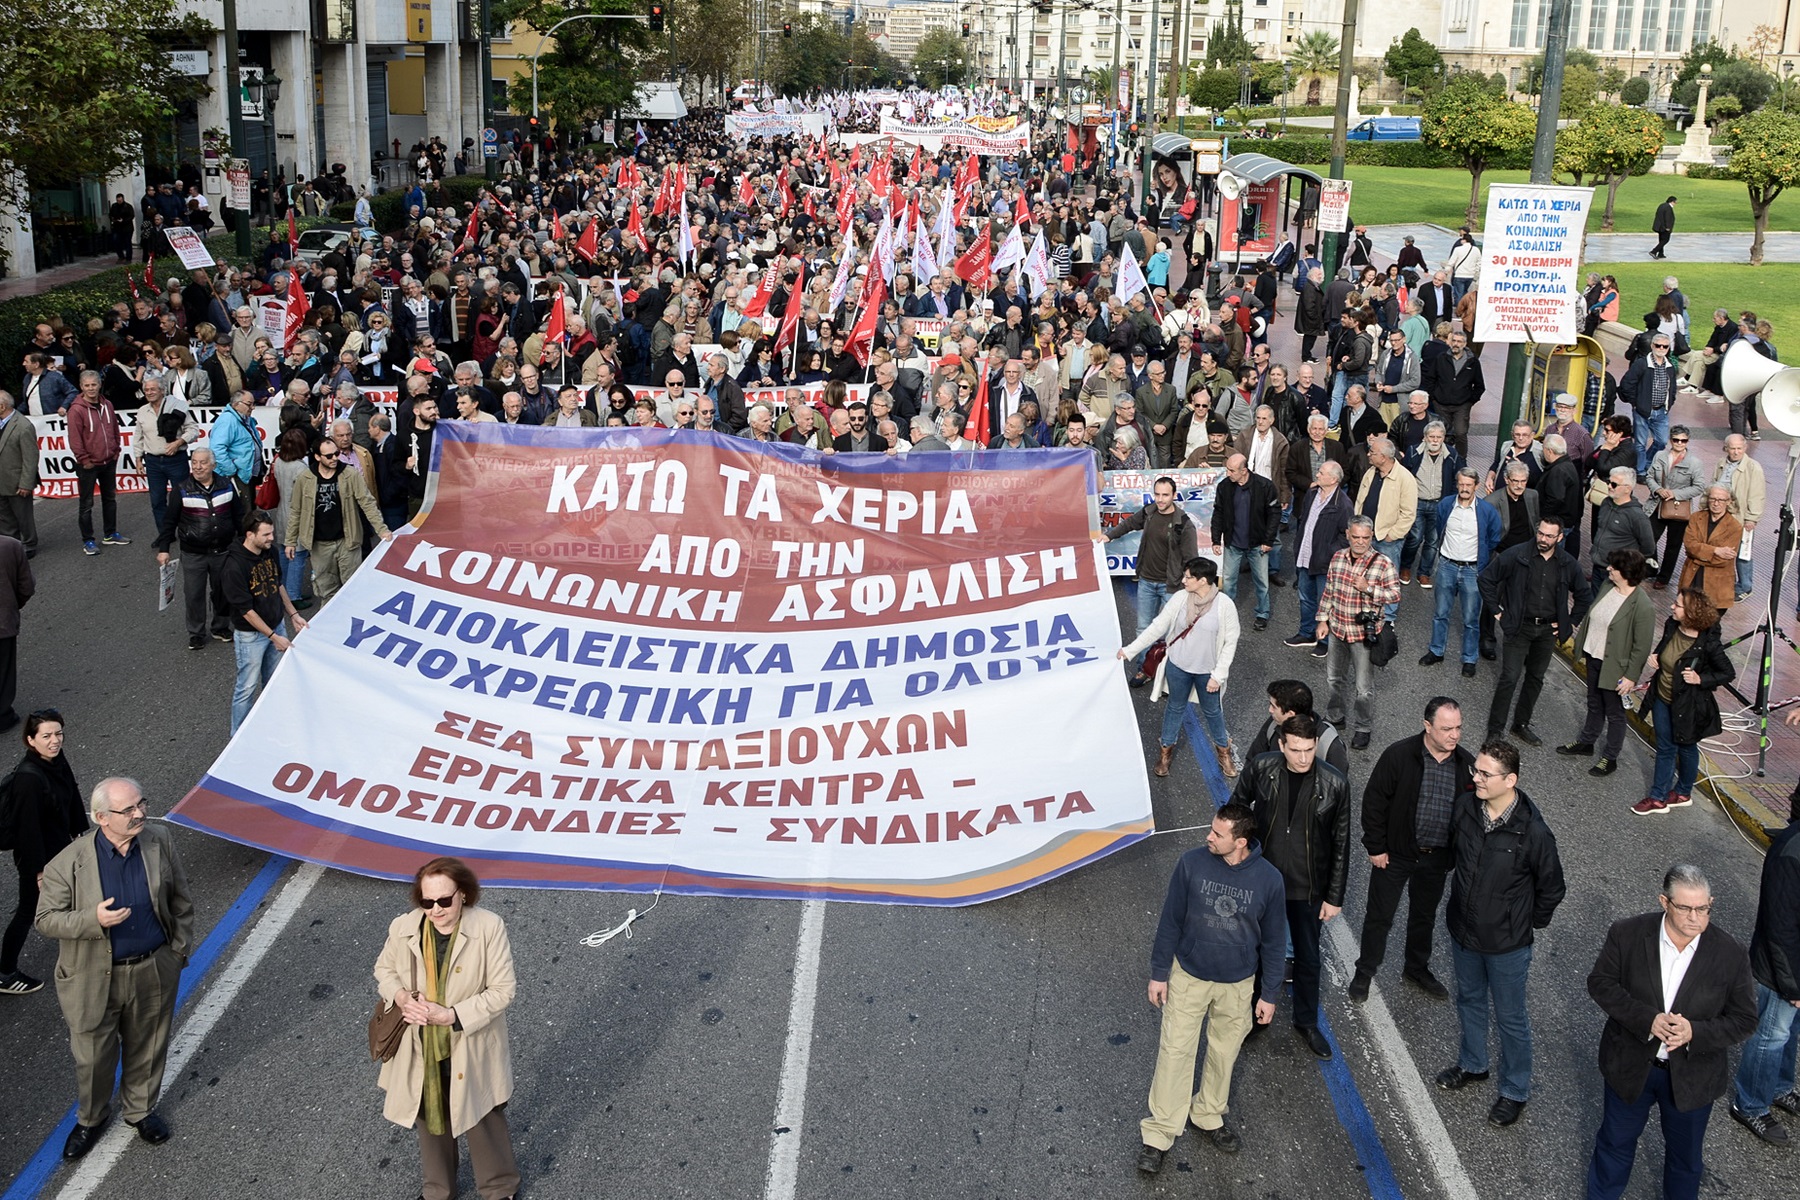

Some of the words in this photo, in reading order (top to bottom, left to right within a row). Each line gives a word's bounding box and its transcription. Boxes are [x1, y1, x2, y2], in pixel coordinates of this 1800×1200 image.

[1499, 198, 1528, 210] ΚΑΤΩ
[1532, 199, 1547, 210] ΤΑ
[1517, 213, 1537, 222] ΑΠΟ
[1542, 213, 1560, 223] ΤΗΝ
[1505, 225, 1568, 238] ΚΟΙΝΩΝΙΚΗ
[1508, 240, 1562, 252] ΑΣΦΑΛΙΣΗ
[1492, 255, 1507, 265] 30
[1512, 257, 1573, 268] ΝΟΕΜΒΡΗ
[1494, 281, 1567, 294] ΠΡΟΠΥΛΑΙΑ
[1488, 296, 1529, 305] ΕΡΓΑΤΙΚΑ
[1531, 298, 1566, 307] ΚΕΝΤΡΑ
[1494, 306, 1558, 315] ΟΜΟΣΠΟΝΔΙΕΣ
[1501, 314, 1549, 324] ΣΥΝΔΙΚΑΤΑ
[546, 459, 688, 514] ΚΑΤΩ
[719, 463, 783, 522] ΤΑ
[812, 480, 979, 535] ΧΕΡΙΑ
[638, 534, 742, 578] ΑΠΟ
[771, 538, 865, 579] ΤΗΝ
[403, 540, 743, 623] ΚΟΙΝΩΝΙΚΗ
[768, 545, 1079, 623] ΑΣΦΑΛΙΣΗ
[371, 590, 794, 675] ΑΠΟΚΛΕΙΣΤΙΚΑ
[821, 613, 1084, 672] ΔΗΜΟΣΙΑ
[342, 616, 753, 726] ΥΠΟΧΡΕΩΤΙΚΗ
[777, 678, 874, 718] ΓΙΑ
[904, 646, 1099, 698] ΟΛΟΥΣ
[434, 710, 533, 760] ΣΕΑ
[560, 709, 968, 772] ΣΥΝΤΑΞΙΟΥΧΩΝ
[408, 745, 676, 804] ΕΡΓΑΤΙΚΑ
[702, 767, 924, 808] ΚΕΝΤΡΑ
[271, 762, 687, 835] ΟΜΟΣΠΟΝΔΙΕΣ
[766, 790, 1096, 845] ΣΥΝΔΙΚΑΤΑ
[1200, 879, 1253, 904] MICHIGAN
